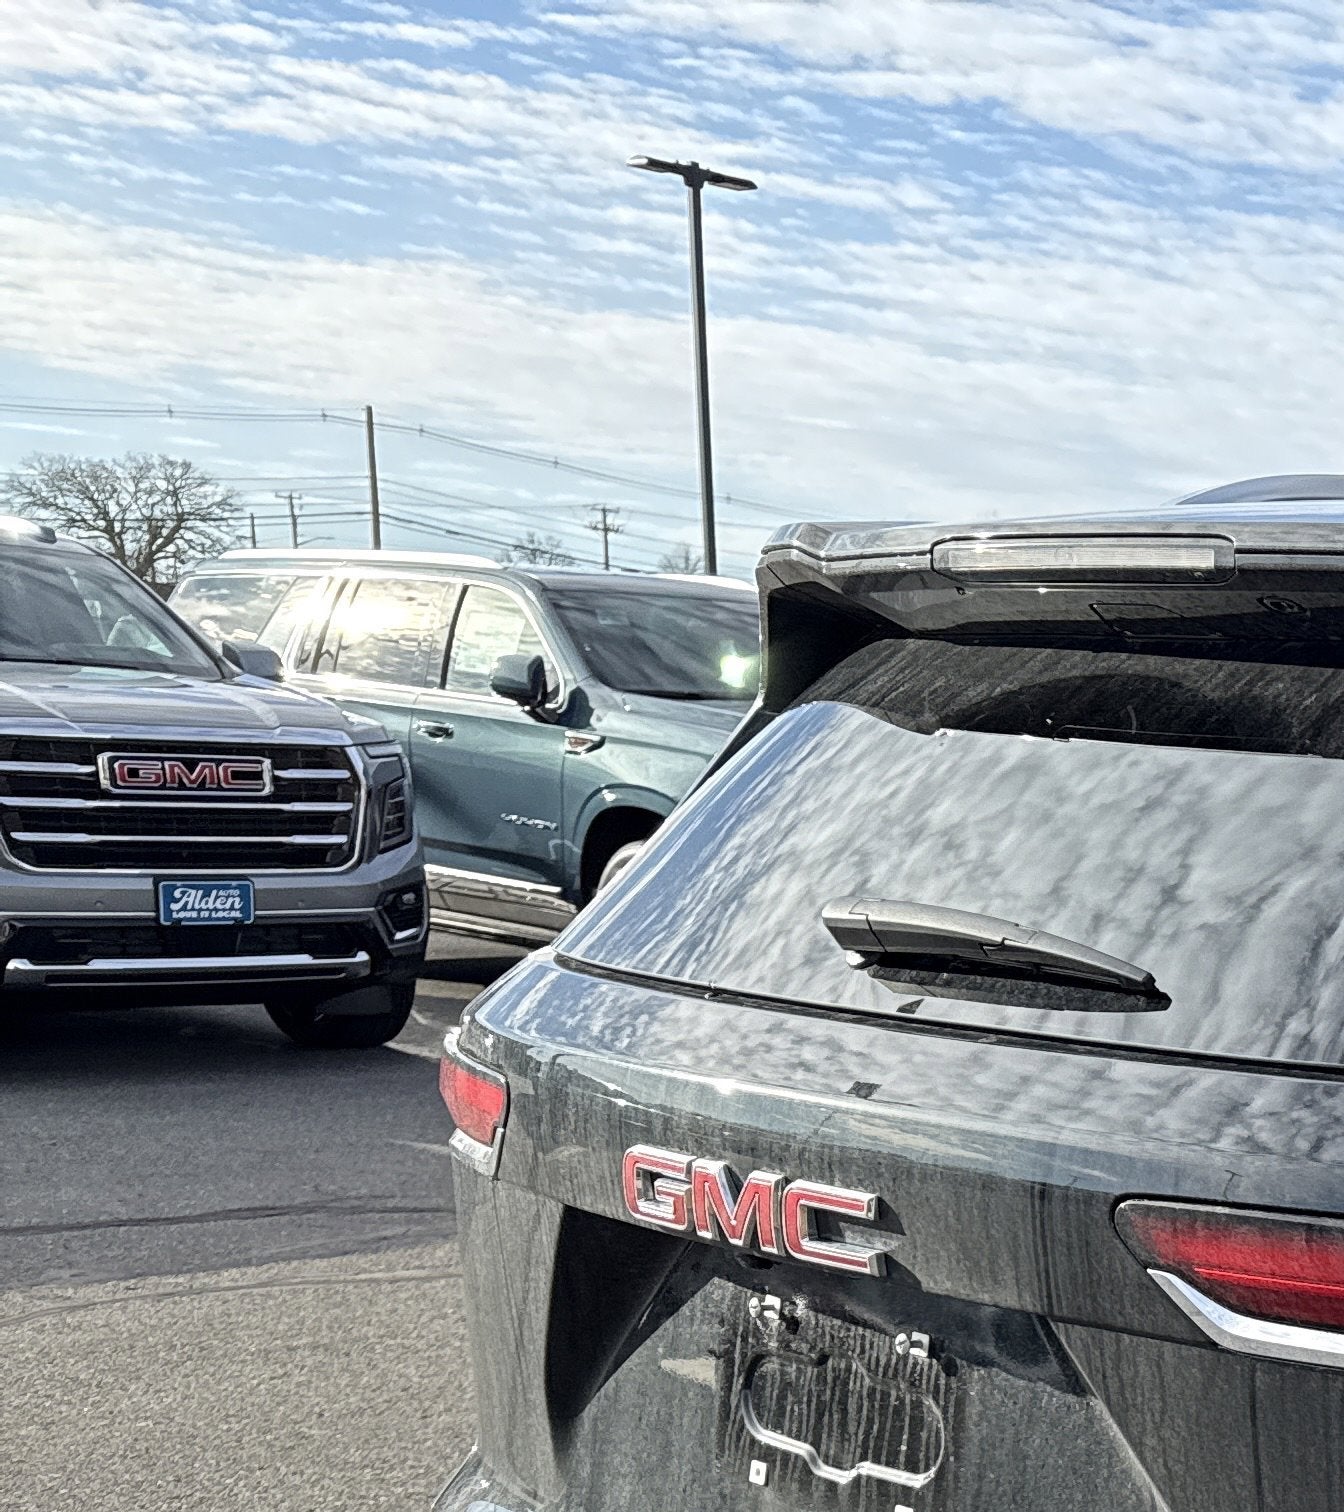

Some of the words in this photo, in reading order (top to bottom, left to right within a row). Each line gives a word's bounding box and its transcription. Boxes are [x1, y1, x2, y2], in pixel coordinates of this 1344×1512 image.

[114, 759, 264, 789] GMC
[170, 887, 243, 911] Alden
[172, 910, 198, 919] LOVE
[211, 911, 243, 919] LOCAL
[623, 1144, 886, 1277] GMC
